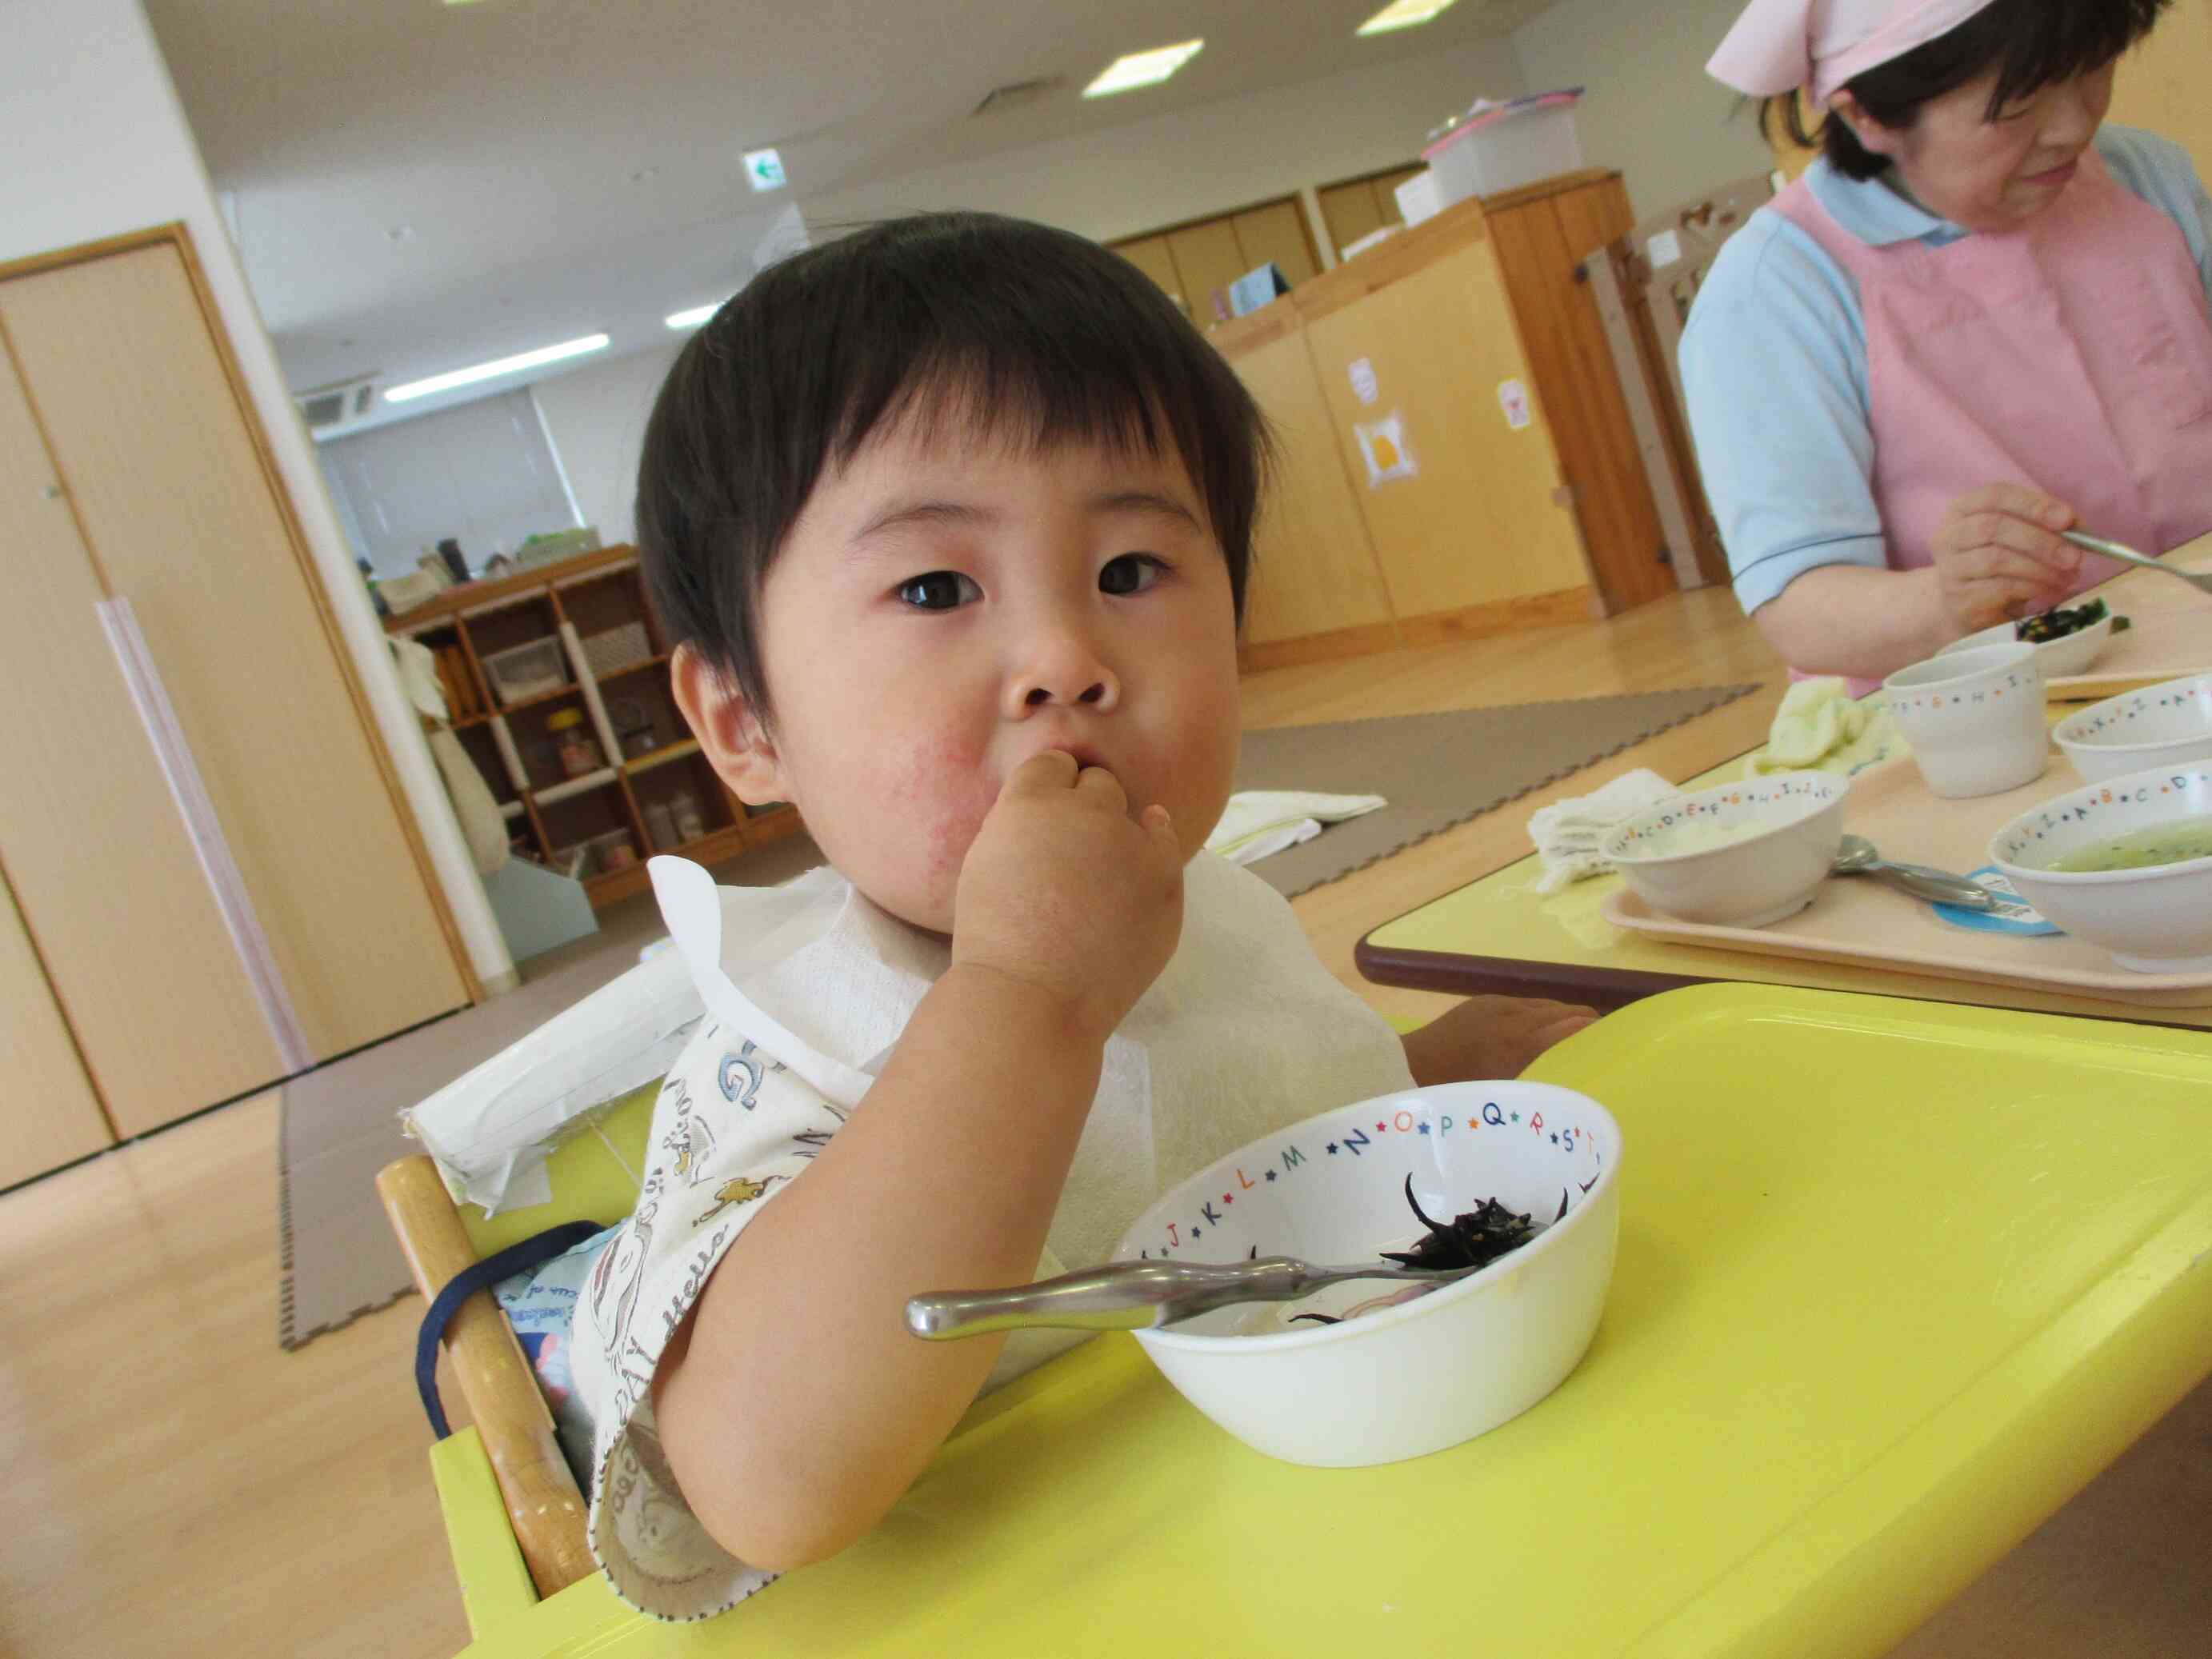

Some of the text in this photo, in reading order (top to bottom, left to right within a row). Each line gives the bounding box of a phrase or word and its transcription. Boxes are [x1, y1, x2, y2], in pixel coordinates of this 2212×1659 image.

[1166, 1222, 1179, 1247] J
[1201, 1201, 1222, 1226] K
[1237, 1168, 1255, 1190] L
[1281, 1145, 1306, 1172] M
[1342, 1128, 1370, 1156] N
[1394, 1110, 1413, 1133] O
[1441, 1115, 1453, 1137] P
[1482, 1102, 1506, 1125] Q
[1530, 1112, 1543, 1136] R
[1562, 1129, 1574, 1153] S
